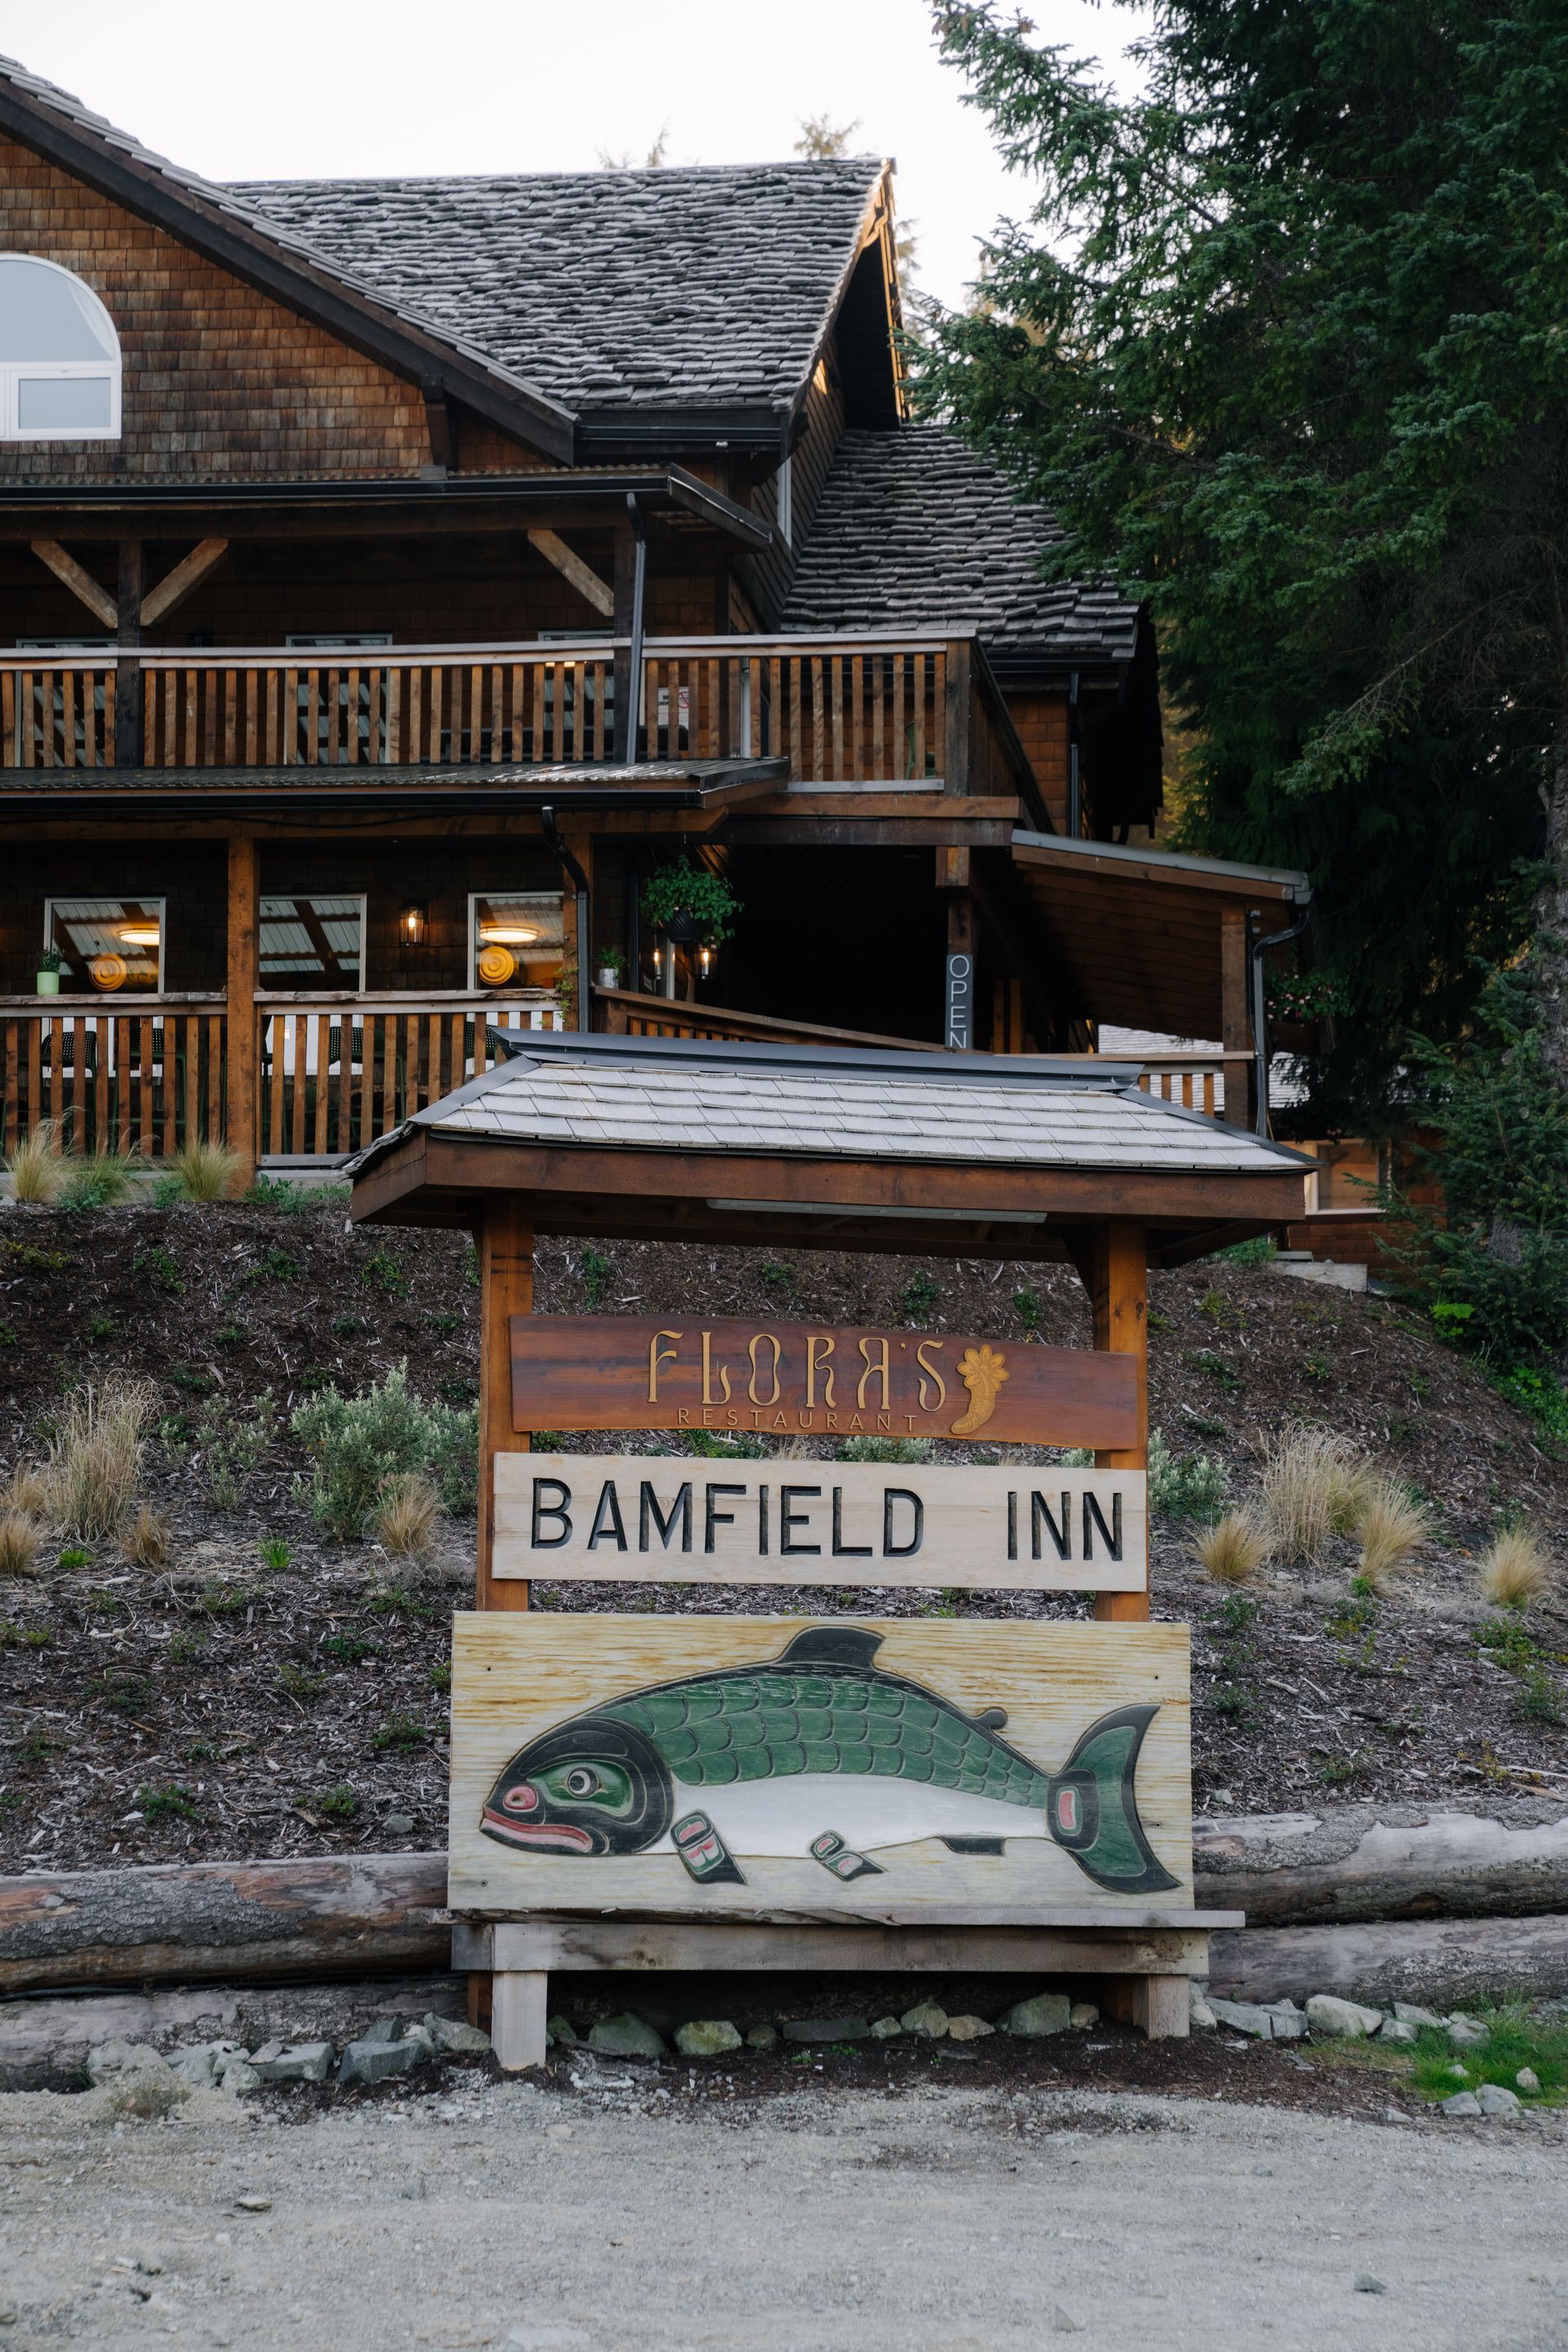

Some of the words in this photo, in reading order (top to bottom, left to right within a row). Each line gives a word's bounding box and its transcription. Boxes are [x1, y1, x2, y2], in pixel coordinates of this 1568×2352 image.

[949, 955, 969, 1049] OPEN
[648, 1330, 946, 1412] FLORA'S
[678, 1408, 916, 1432] RESTAURANT
[532, 1477, 925, 1557] BAMFIELD
[1008, 1490, 1124, 1561] INN
